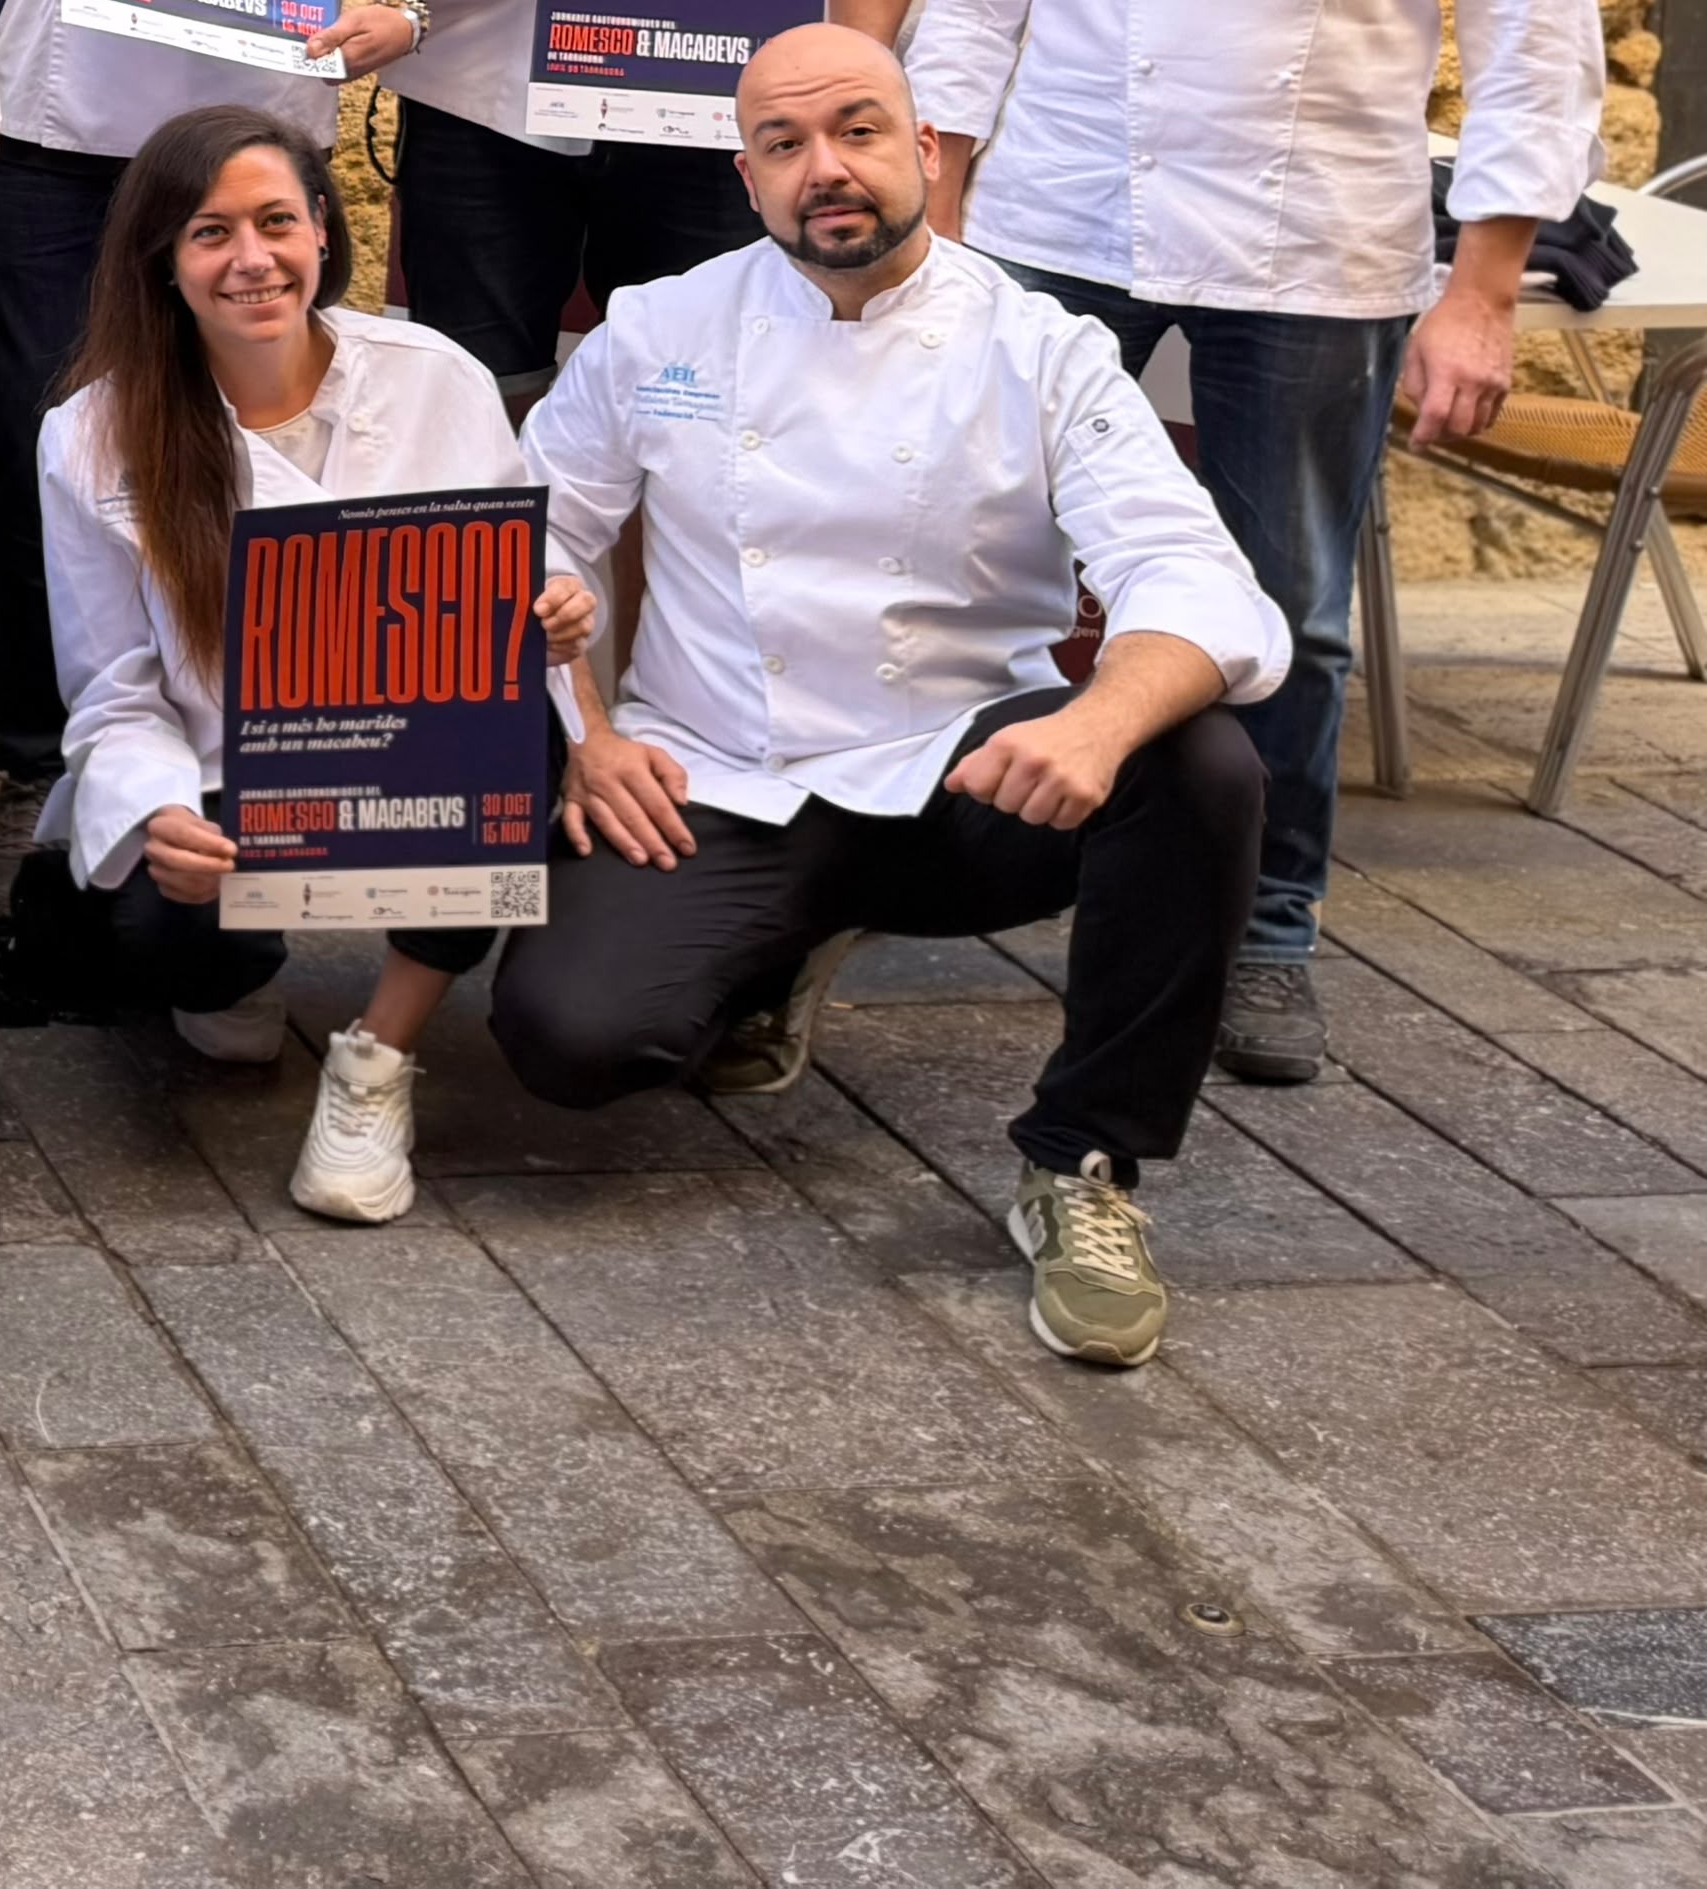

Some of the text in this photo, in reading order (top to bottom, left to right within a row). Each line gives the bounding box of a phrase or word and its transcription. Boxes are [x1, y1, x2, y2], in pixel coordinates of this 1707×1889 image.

[549, 24, 750, 64] ROMESCO & MACABEVS
[241, 519, 530, 710] ROMESCO?
[240, 795, 464, 833] ROMESCO & MACABEVS
[501, 794, 533, 816] OCT
[500, 820, 530, 844] NOV
